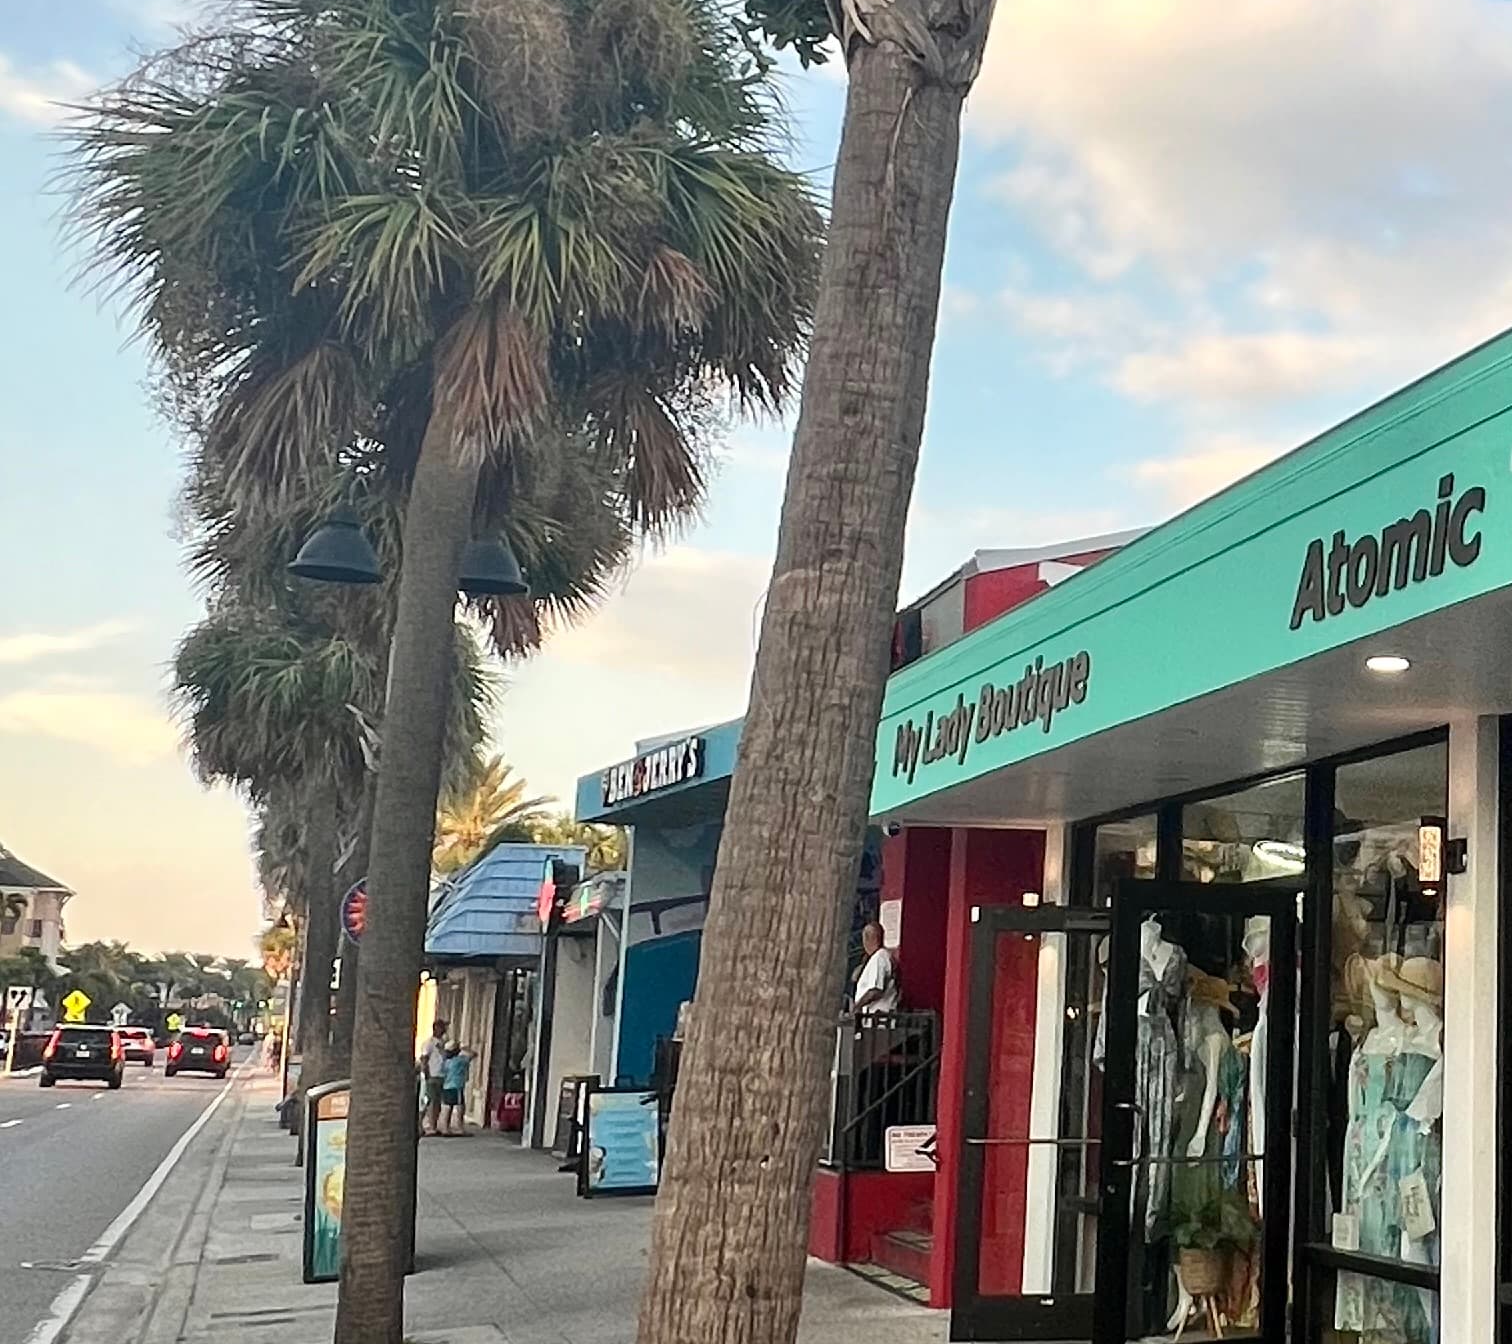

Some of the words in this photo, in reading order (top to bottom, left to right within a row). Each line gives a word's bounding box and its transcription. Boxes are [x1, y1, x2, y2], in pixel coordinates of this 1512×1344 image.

[1289, 472, 1486, 630] Atomic
[892, 719, 923, 785] My
[922, 692, 976, 766] Lady
[975, 650, 1090, 744] Boutique
